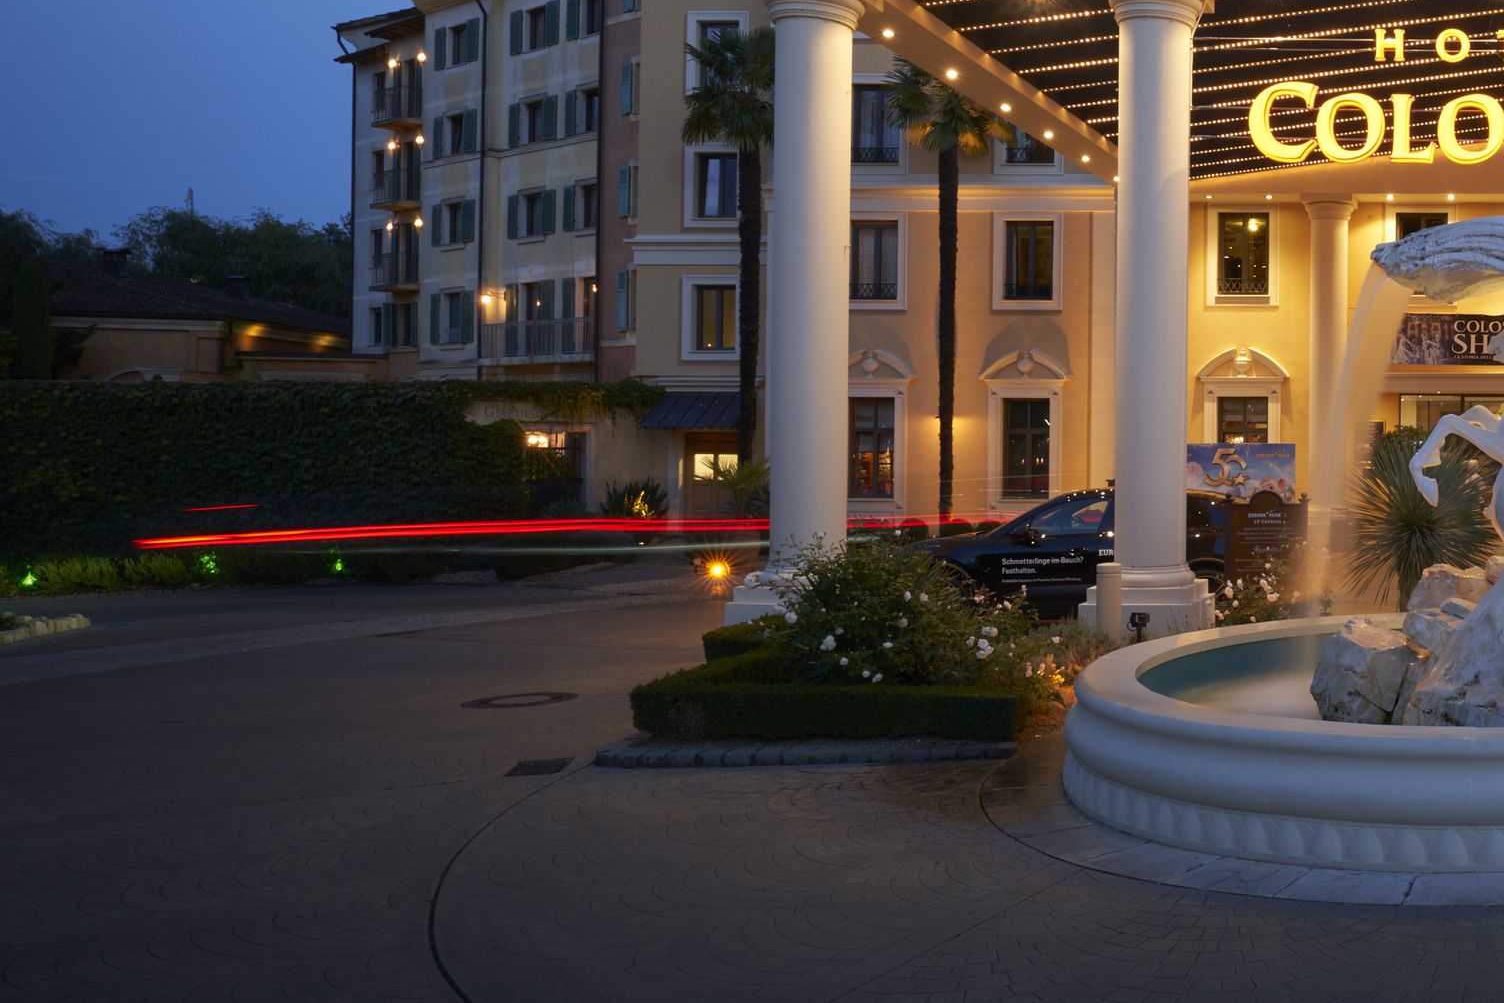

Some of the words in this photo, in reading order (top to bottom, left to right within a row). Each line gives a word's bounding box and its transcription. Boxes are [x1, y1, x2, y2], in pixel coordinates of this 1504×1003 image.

[1001, 557, 1050, 566] Schmetterlinge
[1060, 556, 1084, 564] Bauch?
[1001, 567, 1038, 575] Festhalten.
